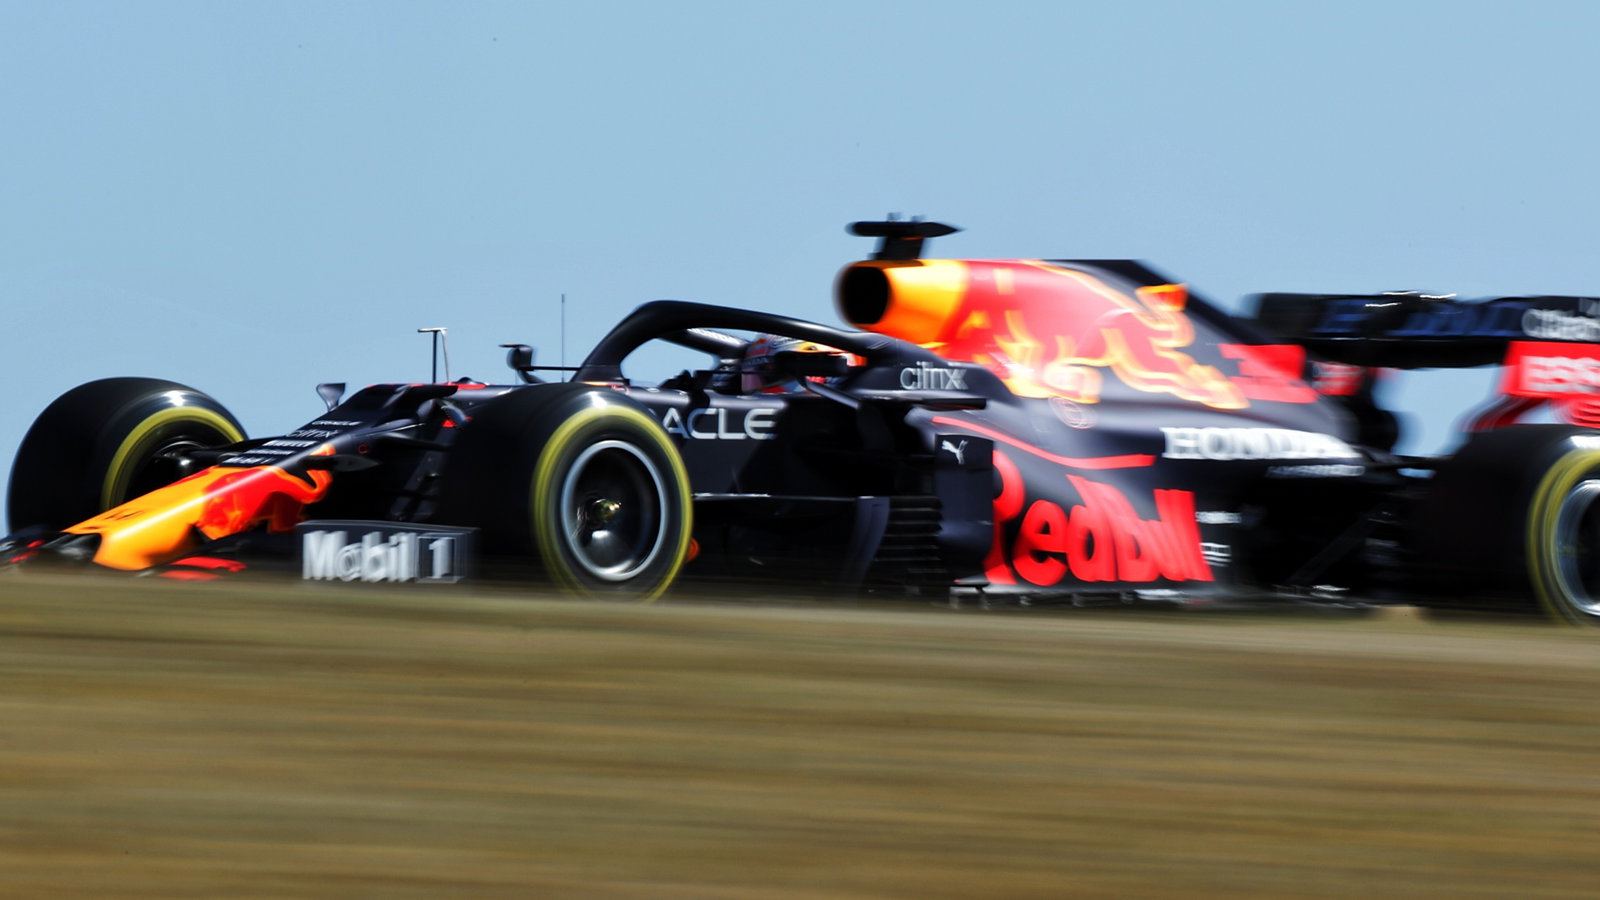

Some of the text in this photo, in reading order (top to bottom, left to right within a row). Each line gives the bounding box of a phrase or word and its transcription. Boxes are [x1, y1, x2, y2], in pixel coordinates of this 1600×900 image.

[662, 407, 778, 440] ACLE
[303, 530, 451, 583] Mobil 1
